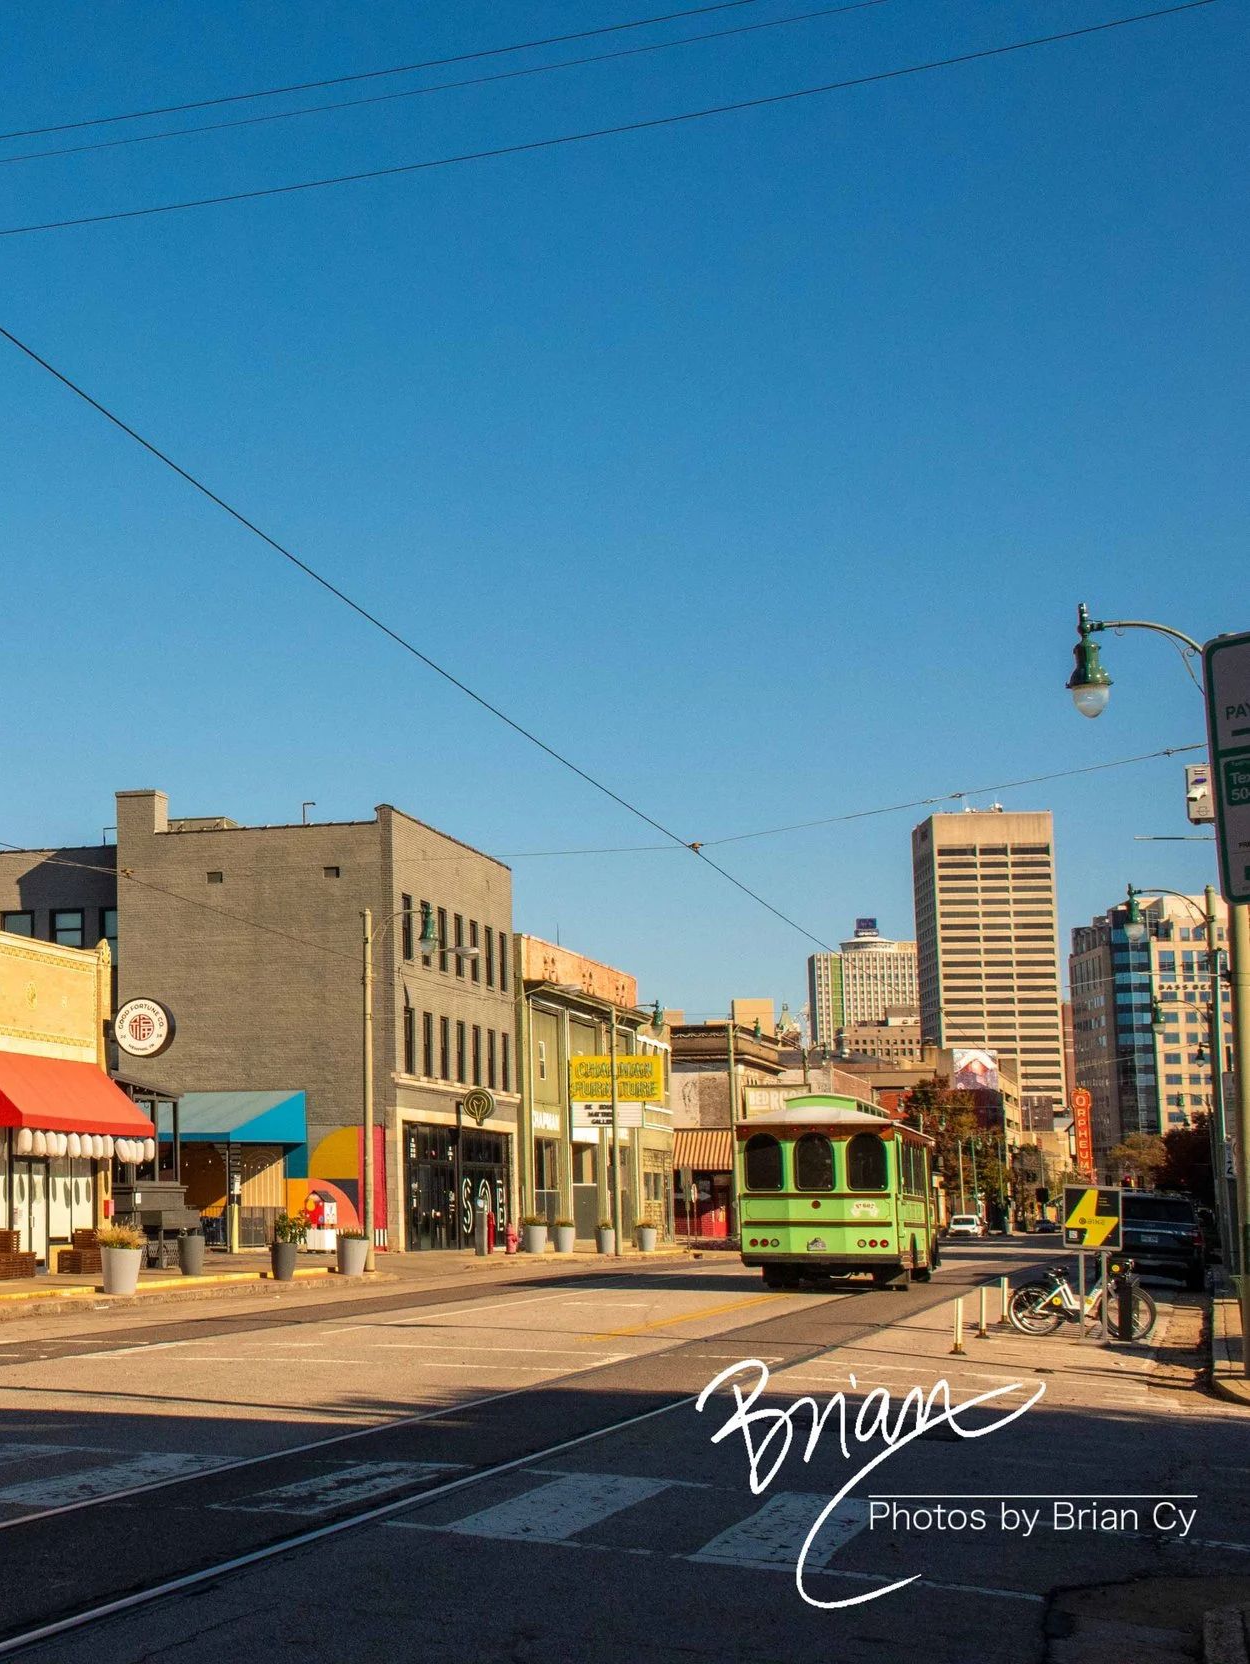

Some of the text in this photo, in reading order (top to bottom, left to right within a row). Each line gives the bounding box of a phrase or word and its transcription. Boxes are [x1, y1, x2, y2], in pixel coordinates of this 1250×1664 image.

[1232, 787, 1250, 800] 50
[118, 1010, 130, 1029] GOOD
[130, 1003, 160, 1016] FORTUNE
[575, 1062, 654, 1079] CHAMAN
[572, 1081, 658, 1098] FURNTURE
[1075, 1096, 1089, 1170] ORPHEUM
